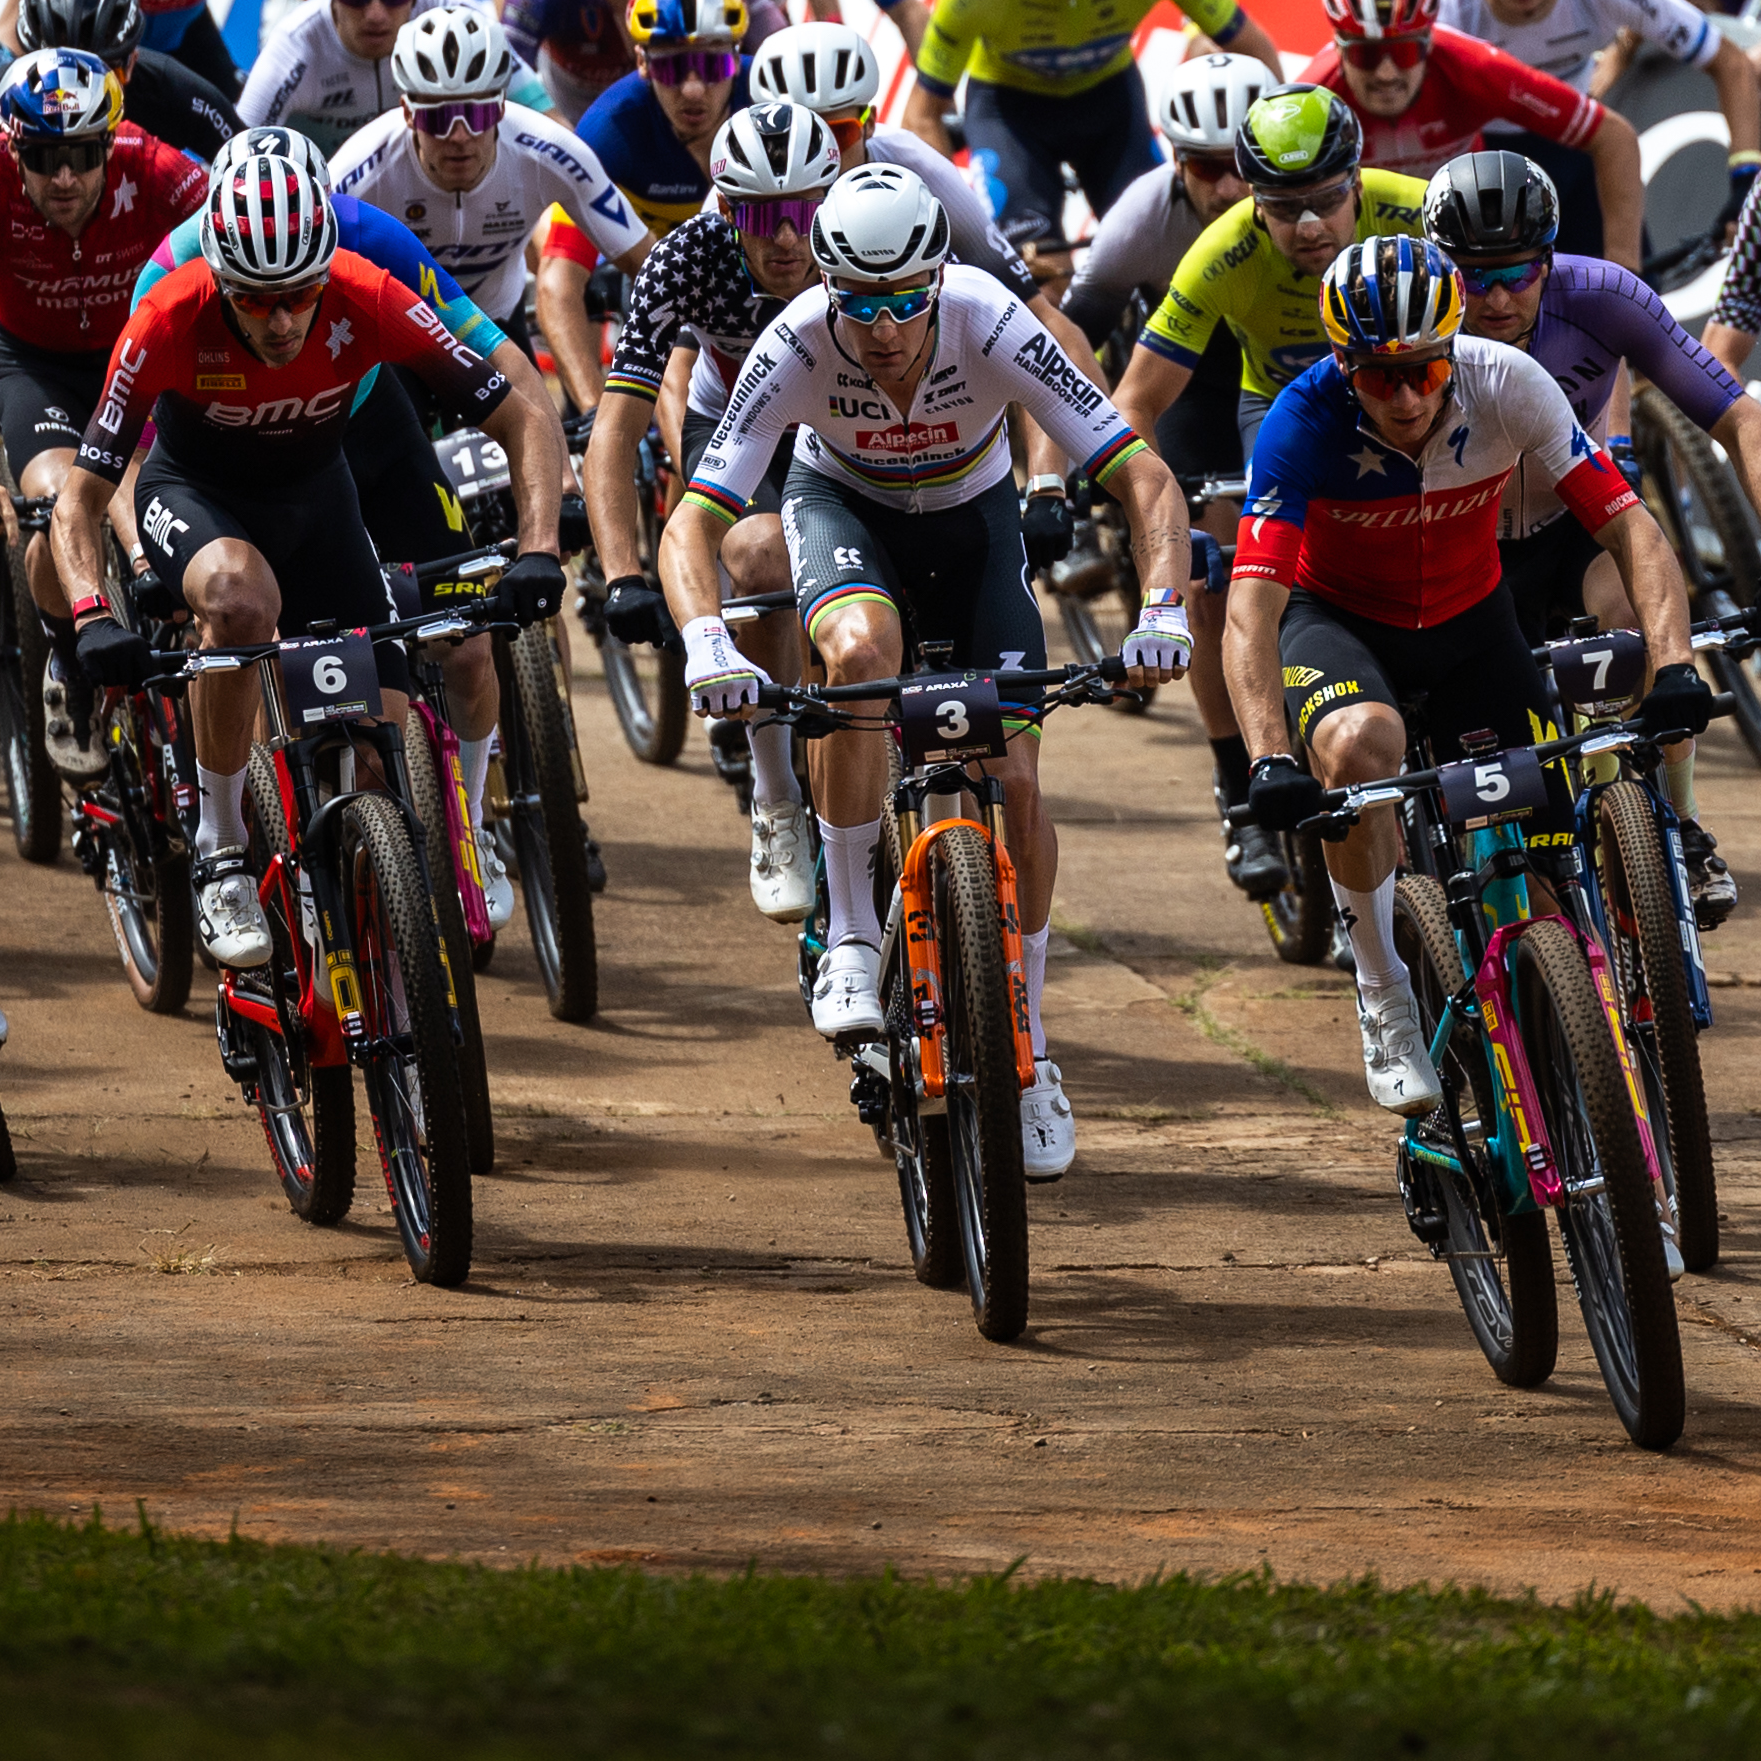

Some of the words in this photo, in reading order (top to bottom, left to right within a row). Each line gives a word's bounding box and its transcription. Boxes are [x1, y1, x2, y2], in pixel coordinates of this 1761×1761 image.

[514, 132, 593, 185] GIANT
[405, 301, 485, 369] BMC
[98, 338, 147, 435] BMC
[474, 370, 506, 401] BOS
[1013, 352, 1041, 380] HAIR
[1043, 375, 1092, 419] BOOSTER
[1019, 331, 1104, 411] Alpecin
[204, 381, 353, 428] BMC
[709, 351, 778, 451] deceuninck
[738, 392, 772, 436] WINDOWS
[839, 397, 891, 421] UCI
[924, 395, 975, 415] CANYON
[78, 441, 125, 470] BOSS
[868, 427, 948, 447] Alpecin
[142, 496, 190, 558] BMC
[312, 655, 348, 694] 6
[1581, 650, 1614, 690] 7
[935, 700, 971, 739] 3
[1473, 762, 1511, 802] 5
